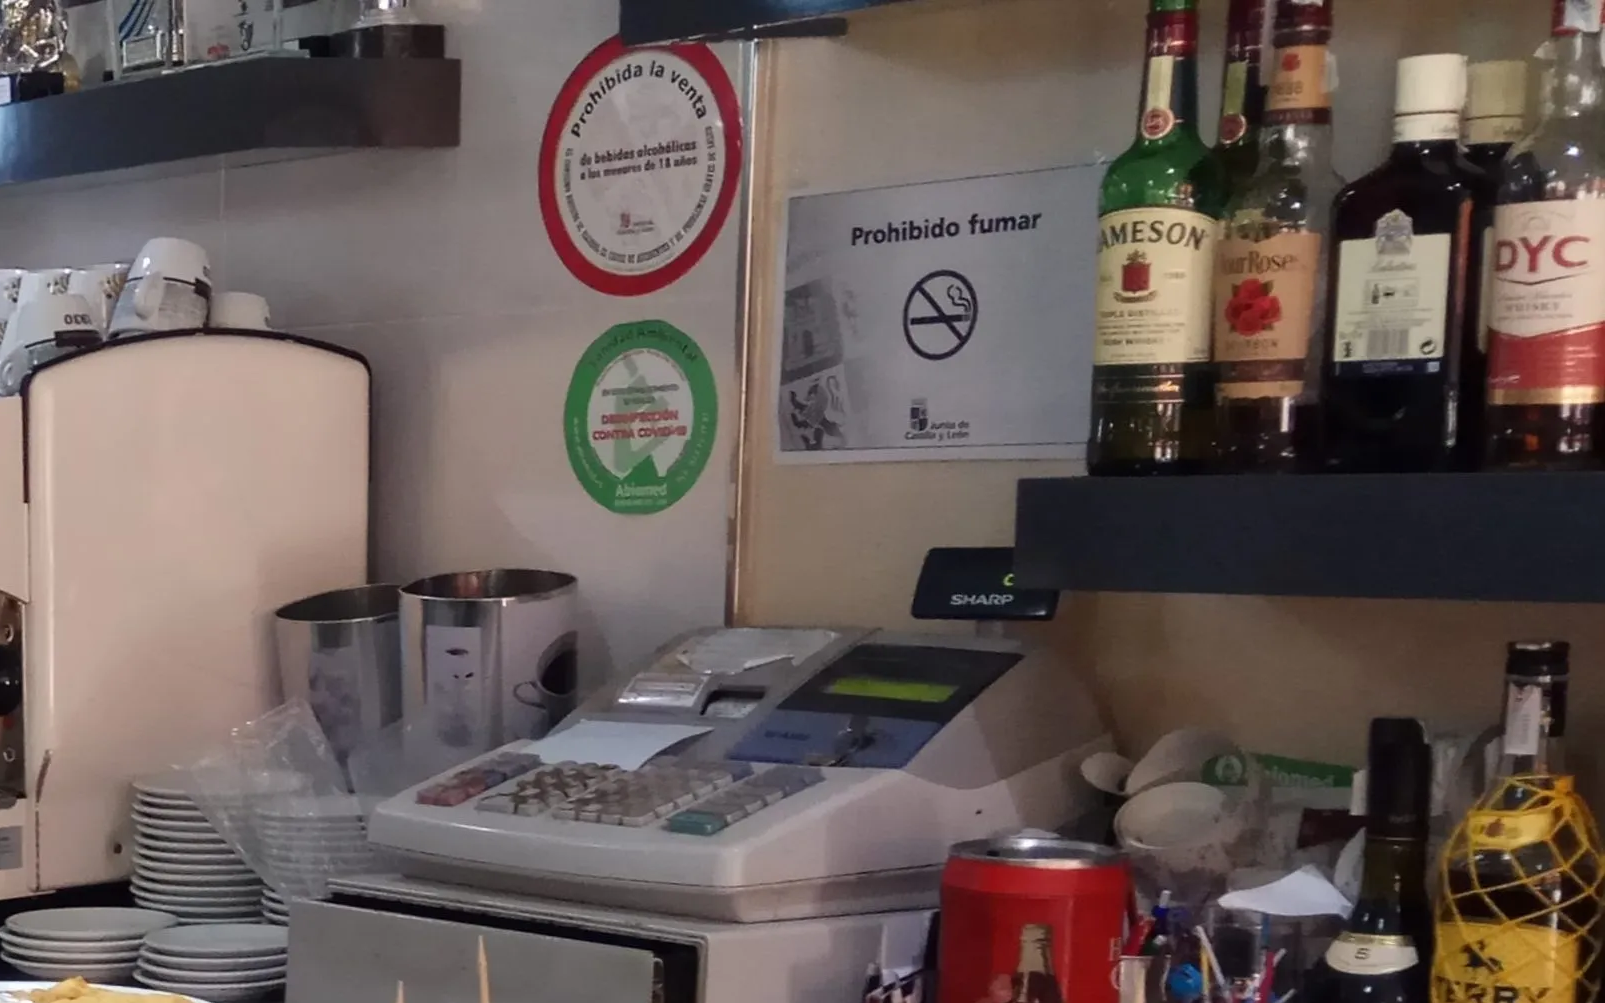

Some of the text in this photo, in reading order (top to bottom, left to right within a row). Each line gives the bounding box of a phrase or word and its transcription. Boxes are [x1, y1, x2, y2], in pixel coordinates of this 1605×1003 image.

[571, 60, 707, 138] Prohibida la venta
[580, 140, 697, 167] de bebidas alcohólicas
[603, 164, 642, 177] menores
[645, 159, 656, 171] de
[659, 157, 672, 169] 18
[673, 155, 698, 168] años
[851, 212, 1042, 246] Prohibido fumar
[1098, 220, 1206, 251] AMESON
[1248, 250, 1300, 275] Rose
[1493, 235, 1591, 273] DYC
[593, 428, 635, 441] CONTRA
[950, 594, 1014, 605] SHARP
[1354, 948, 1371, 960] 5
